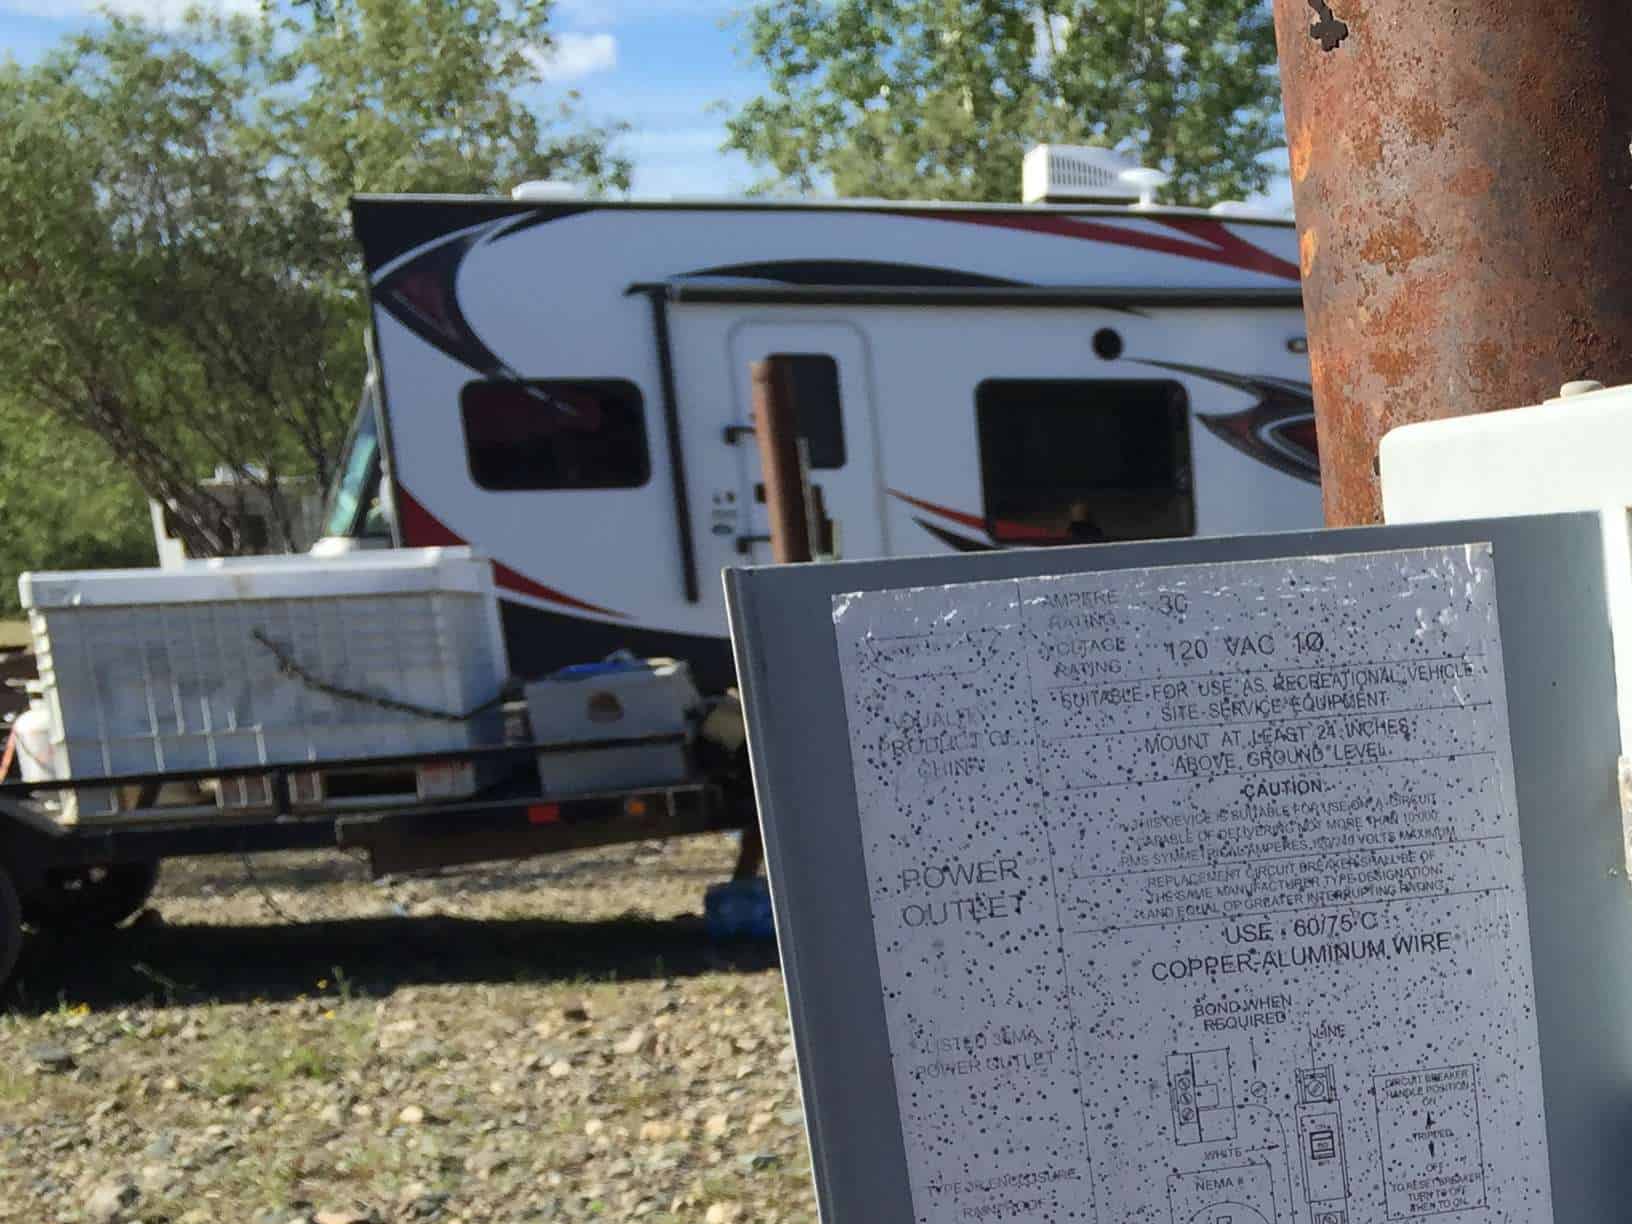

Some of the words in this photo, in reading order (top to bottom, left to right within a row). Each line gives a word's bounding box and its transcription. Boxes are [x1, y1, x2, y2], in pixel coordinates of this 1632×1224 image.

[1164, 638, 1209, 662] 120
[1223, 633, 1275, 657] VAC
[1054, 657, 1122, 678] RATING
[1059, 685, 1142, 709] SUITABLE
[1151, 682, 1188, 701] FOR
[1197, 678, 1232, 697] USE
[1241, 677, 1265, 694] AS
[1272, 666, 1402, 694] RECREATIONAL
[1407, 661, 1472, 683] VEHICLE
[1292, 689, 1387, 715] EQUIPMENT
[1143, 731, 1210, 753] MOUNT
[1221, 730, 1241, 745] AT
[1250, 724, 1307, 745] LEAST
[1316, 723, 1336, 739] 24
[1345, 717, 1409, 739] INCHES
[1174, 752, 1236, 773] ABOVE
[1246, 745, 1324, 768] GROUND
[901, 858, 1019, 891] POWER
[1146, 868, 1241, 889] REPLACEMENT
[900, 893, 1024, 928] OUTLET
[1224, 921, 1271, 945] USE
[1150, 937, 1386, 982] COPPER-ALUMINUM
[1391, 930, 1453, 956] WIRE
[1193, 999, 1240, 1017] BOND
[1243, 994, 1292, 1012] WHEN
[1203, 1010, 1286, 1032] REQUIRED
[1194, 1176, 1234, 1193] NEMA
